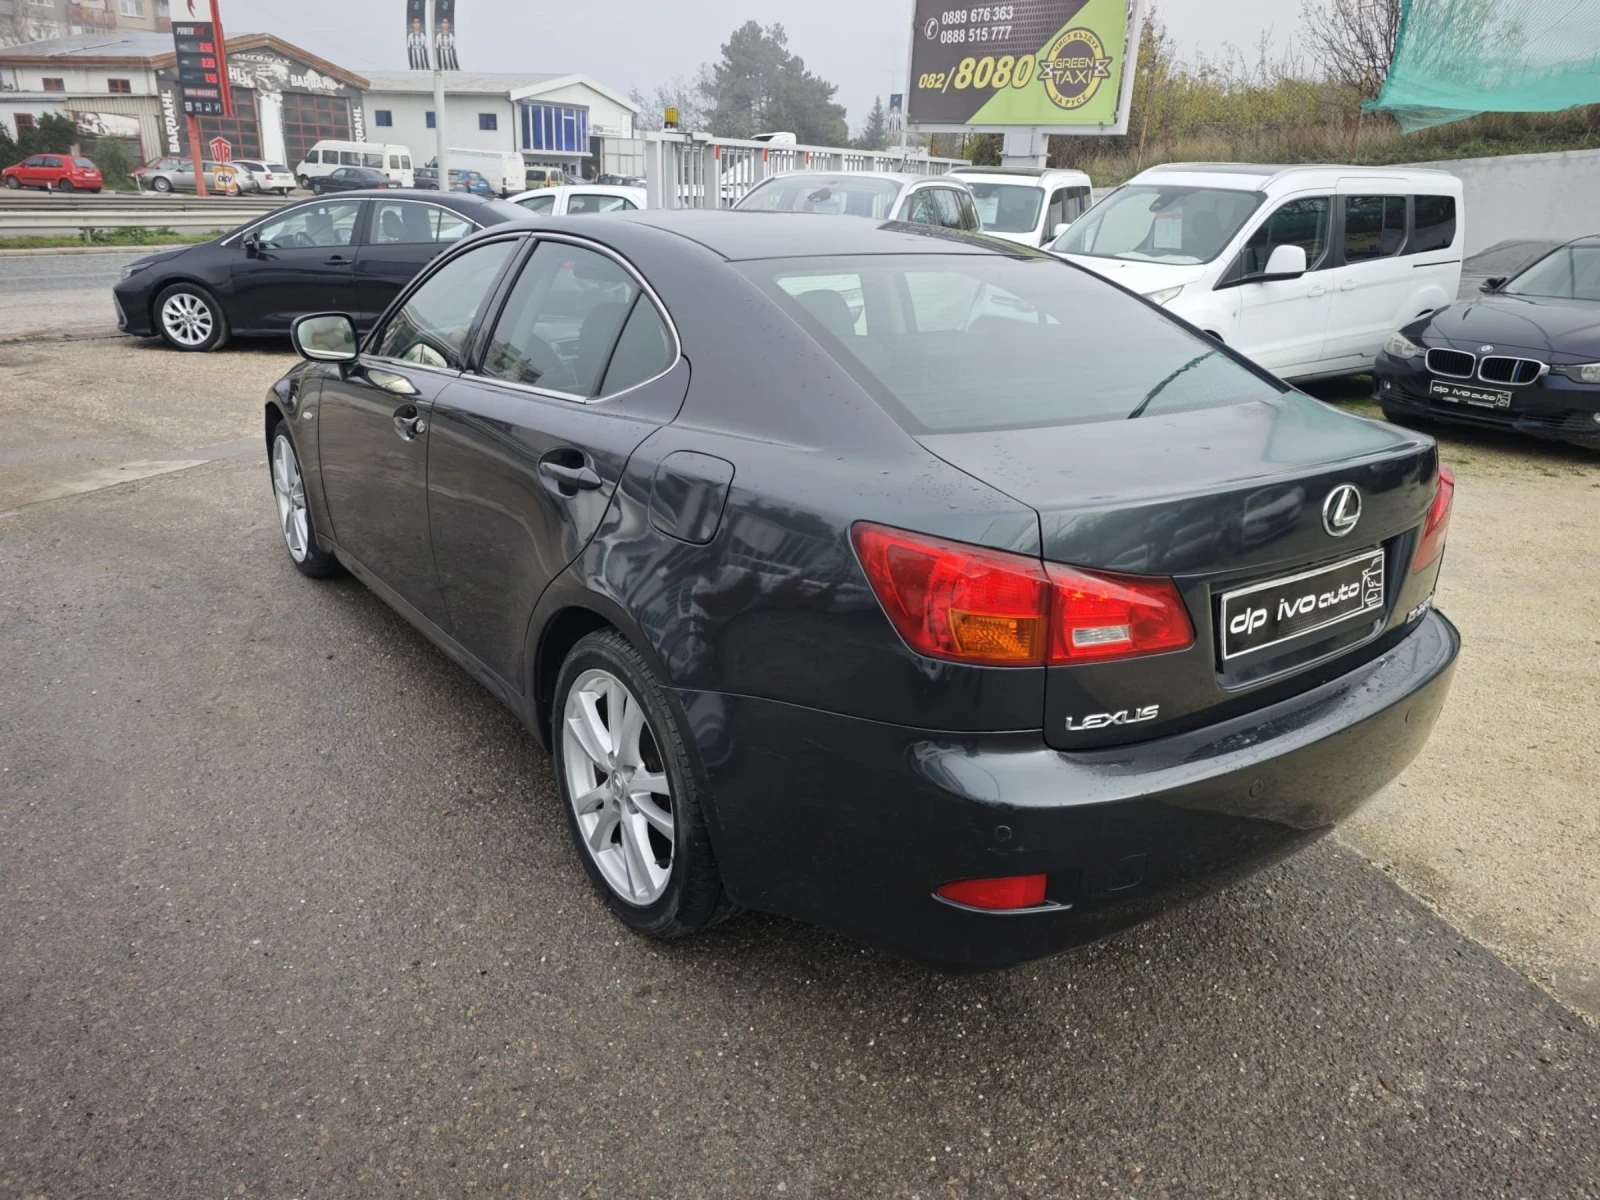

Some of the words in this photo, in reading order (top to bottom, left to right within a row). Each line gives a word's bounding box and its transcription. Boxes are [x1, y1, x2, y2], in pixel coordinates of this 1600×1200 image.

[942, 10, 967, 25] 0889
[970, 8, 990, 22] 676
[992, 5, 1013, 21] 363
[941, 29, 965, 44] 0888
[968, 28, 988, 42] 515
[991, 25, 1012, 40] 777
[1054, 34, 1071, 52] ЧИСТ
[1073, 32, 1099, 50] ВЪЗДУХ
[1054, 57, 1094, 69] GREEN
[1053, 69, 1092, 84] TAXI
[1053, 93, 1063, 104] ЗА
[1065, 93, 1087, 106] РУСЕ
[161, 89, 180, 153] BARDAHL
[1229, 607, 1268, 634] dp
[1276, 597, 1316, 621] ivo
[1318, 583, 1360, 608] auto
[1065, 704, 1160, 731] LEXUS
